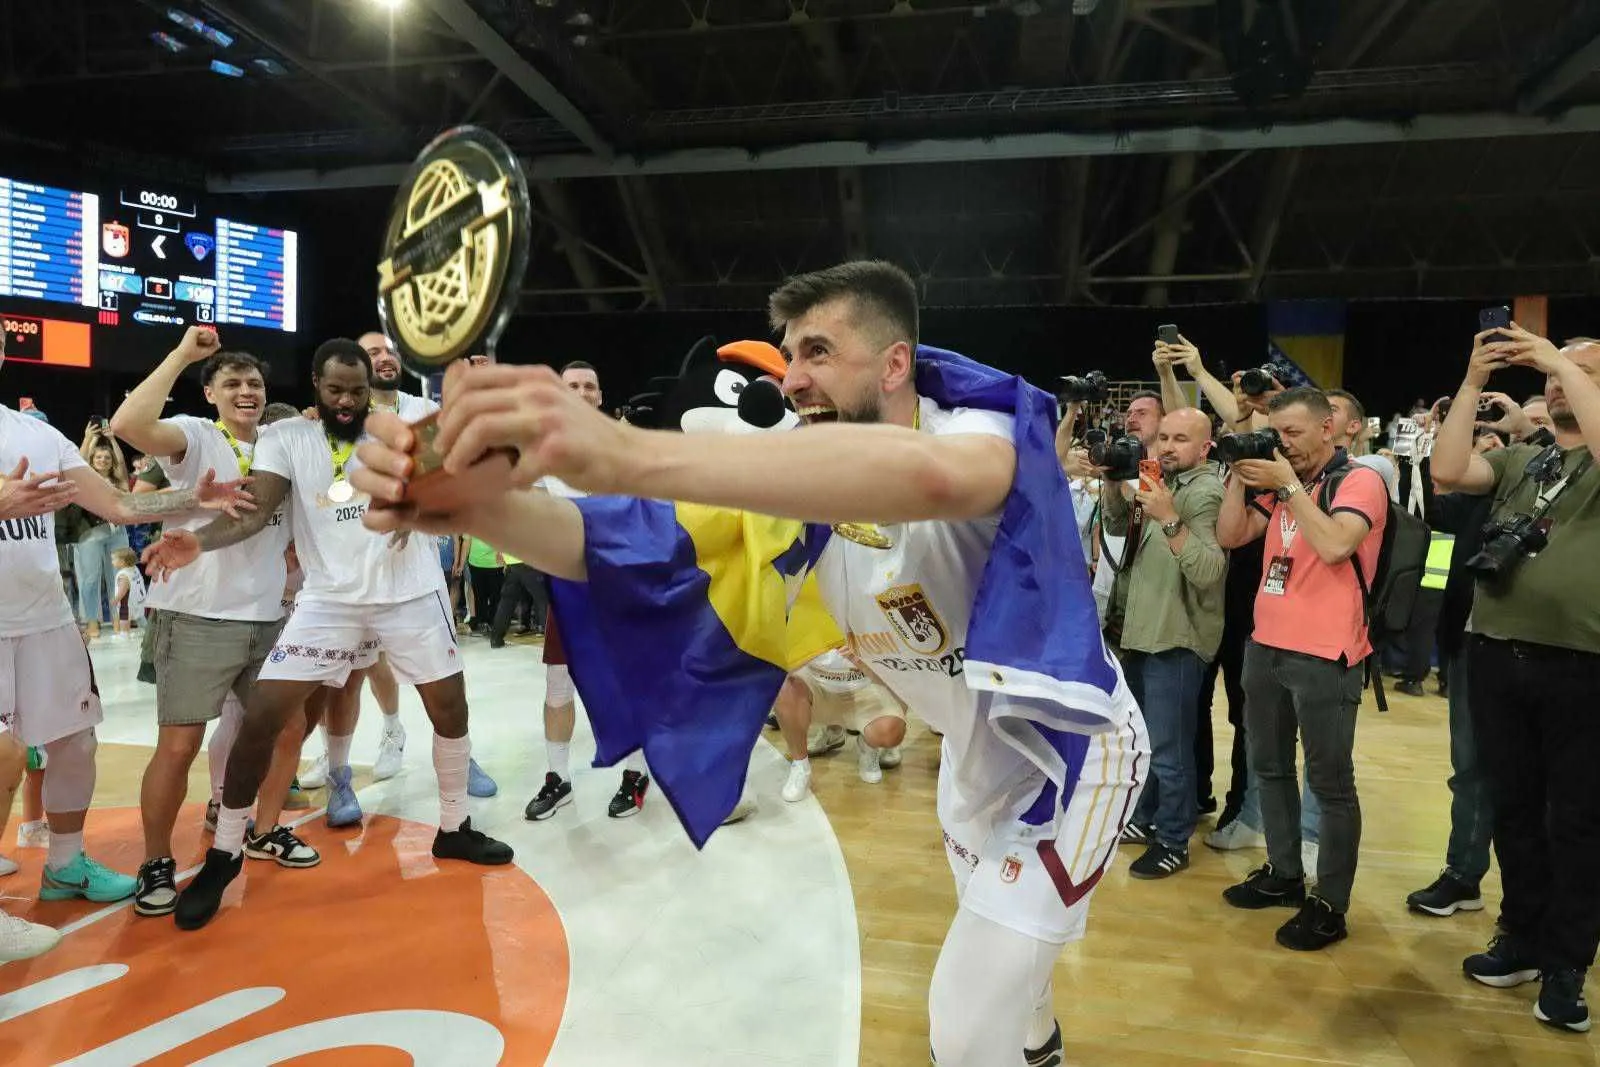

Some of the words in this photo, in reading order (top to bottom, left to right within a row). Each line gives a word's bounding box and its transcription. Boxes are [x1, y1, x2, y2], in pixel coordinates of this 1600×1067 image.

[140, 191, 177, 209] 00:00
[155, 214, 163, 225] 9
[105, 296, 111, 307] 1
[202, 309, 209, 320] 0
[335, 504, 365, 522] 2025
